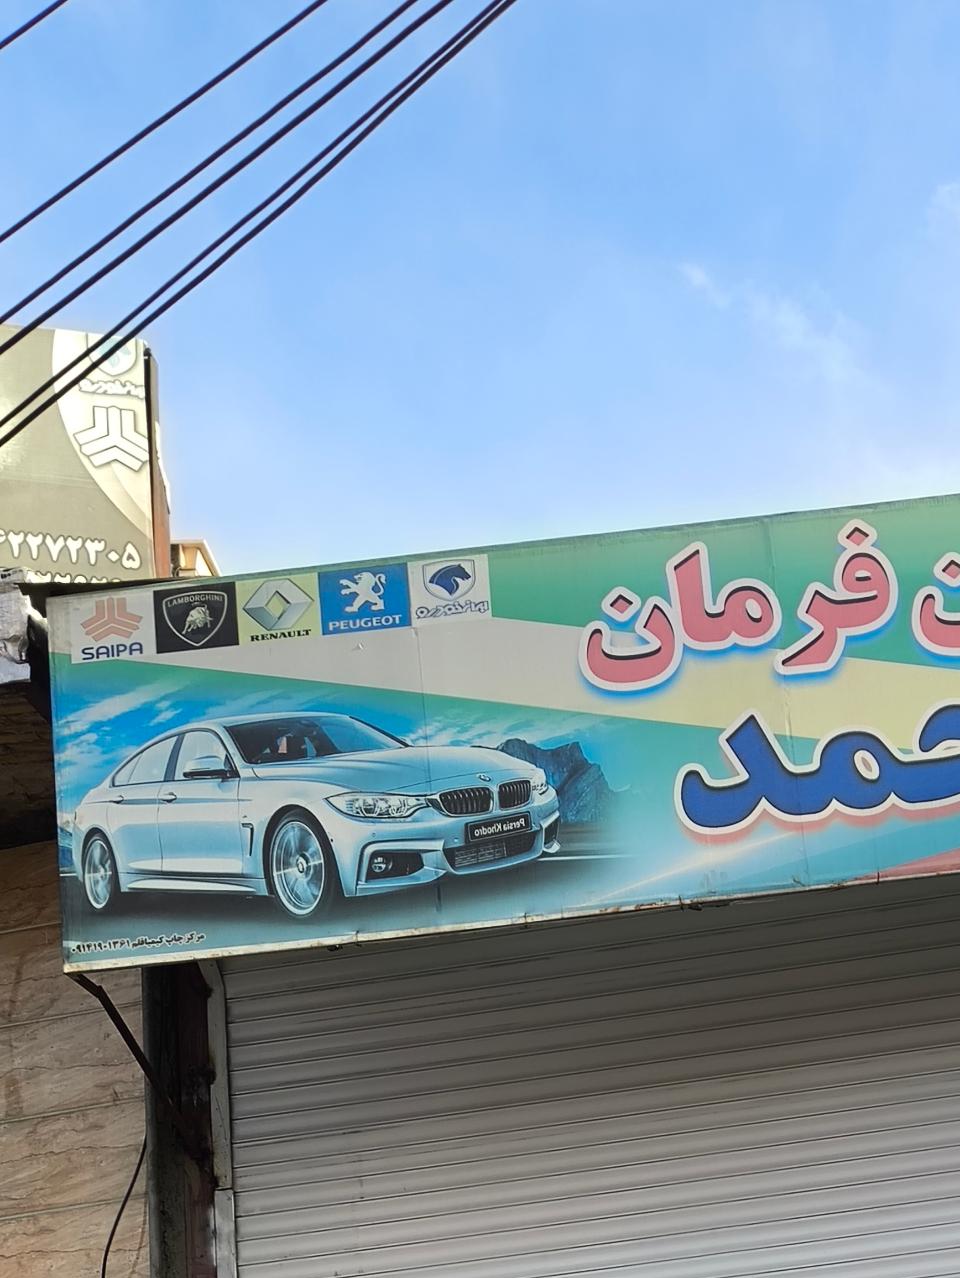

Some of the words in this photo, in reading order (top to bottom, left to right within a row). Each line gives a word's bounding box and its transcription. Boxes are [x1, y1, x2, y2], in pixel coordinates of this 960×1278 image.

[167, 594, 223, 607] LAMBORGHINI
[580, 519, 897, 691] فرمان
[329, 615, 402, 630] PEUGEOT
[250, 629, 311, 641] RENAULT
[82, 642, 143, 660] SAIPA
